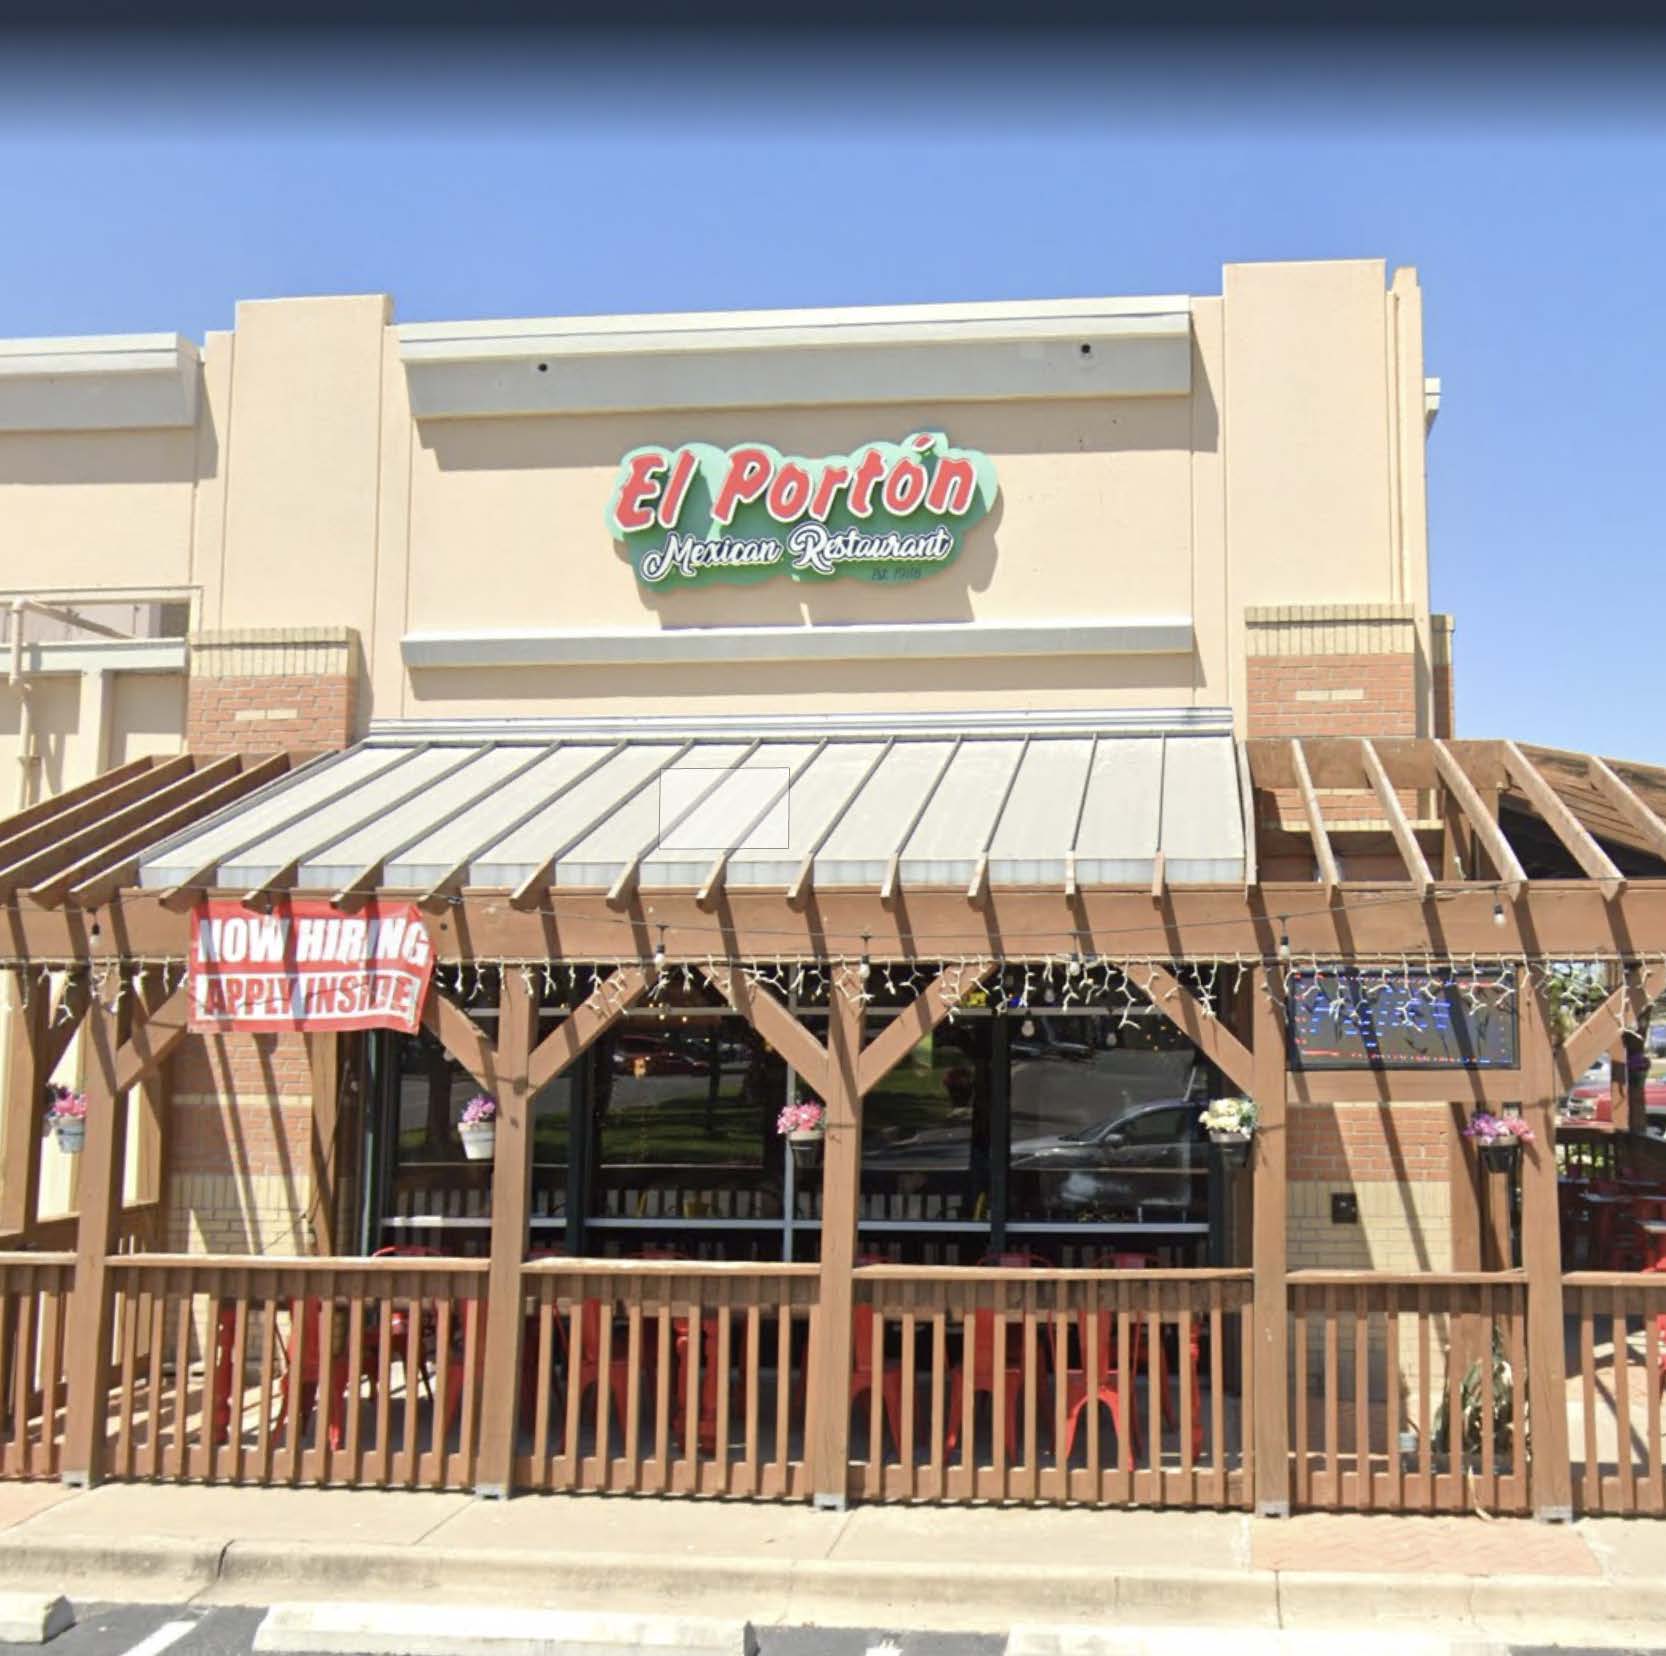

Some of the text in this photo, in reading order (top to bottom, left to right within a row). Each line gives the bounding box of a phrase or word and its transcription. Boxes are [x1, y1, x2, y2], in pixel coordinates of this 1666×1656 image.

[614, 433, 976, 531] El Portón
[641, 522, 953, 581] Mexican Restaurant
[197, 917, 430, 968] NOW HIRING
[204, 976, 414, 1015] APPLY INSIDE
